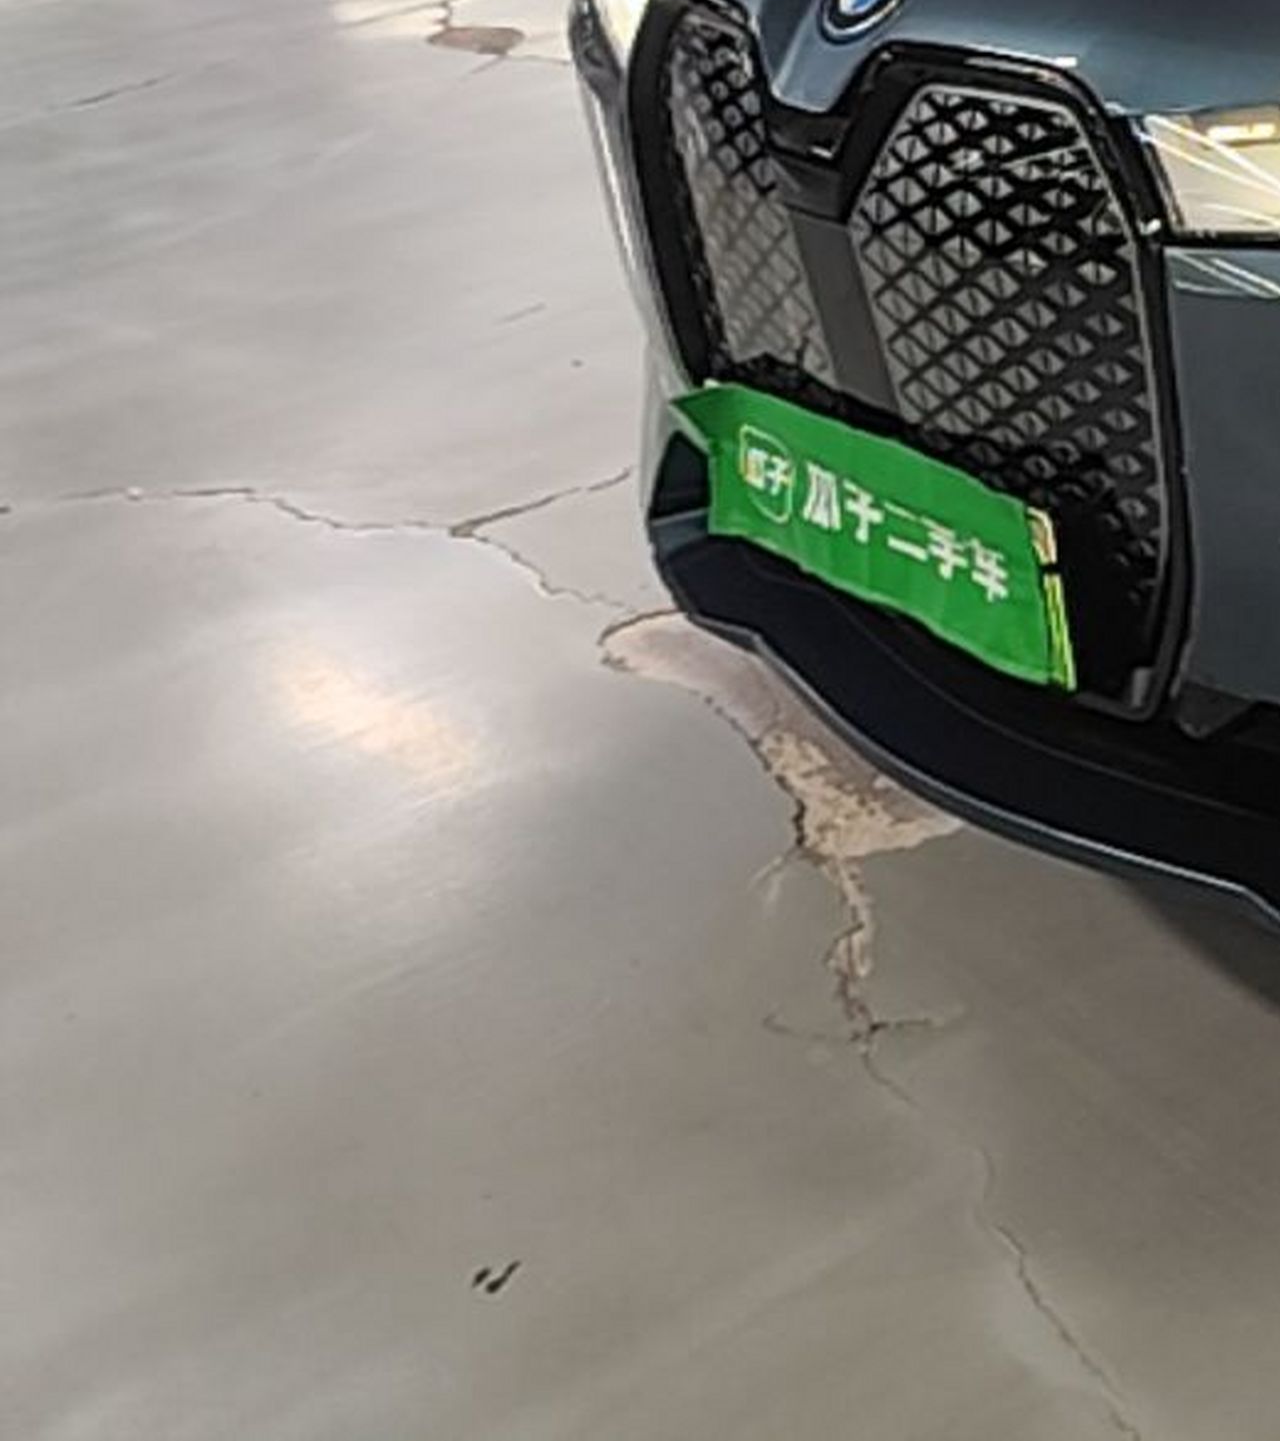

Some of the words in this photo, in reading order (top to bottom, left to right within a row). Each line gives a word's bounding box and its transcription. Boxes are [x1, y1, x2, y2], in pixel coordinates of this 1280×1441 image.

[803, 462, 1009, 602] 瓜子二手车
